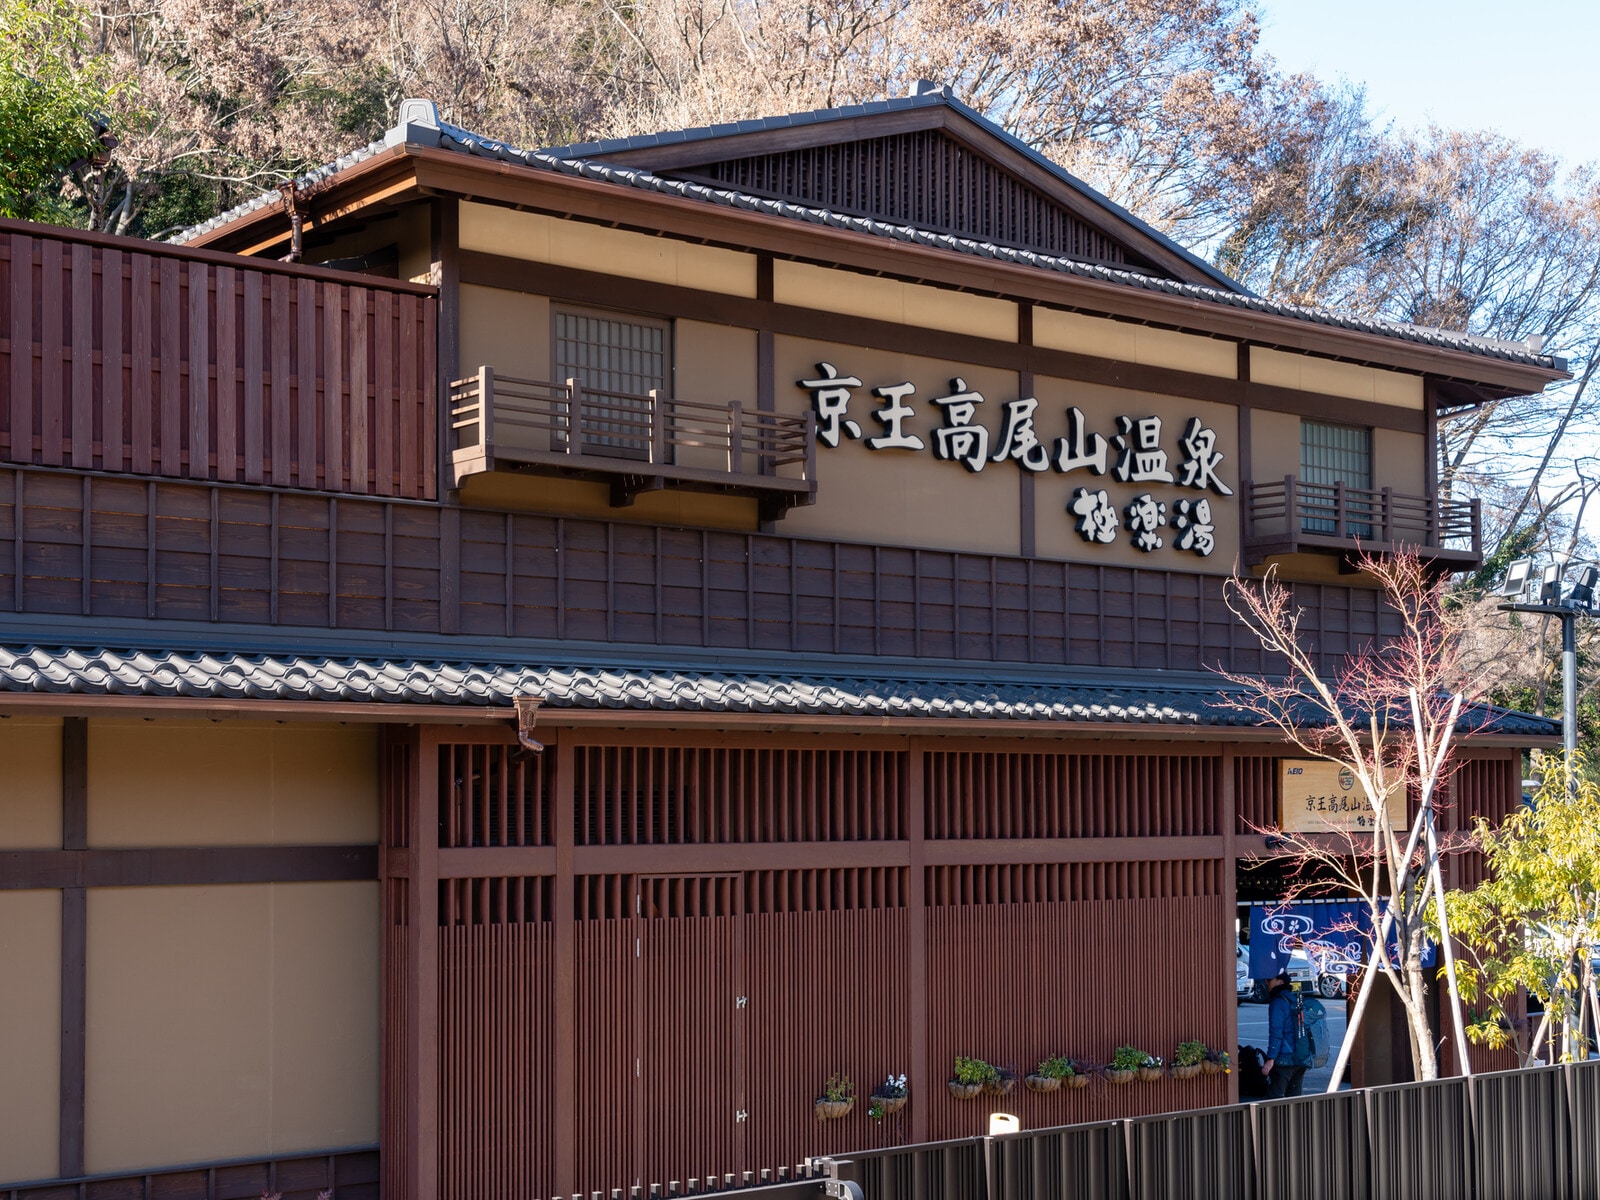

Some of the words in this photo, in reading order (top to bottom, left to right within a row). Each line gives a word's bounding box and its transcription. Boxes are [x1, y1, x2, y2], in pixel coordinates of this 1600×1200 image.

[797, 362, 1234, 496] 京王高尾山温泉
[1067, 487, 1215, 557] 極楽湯
[1305, 794, 1380, 813] 京王高尾山温
